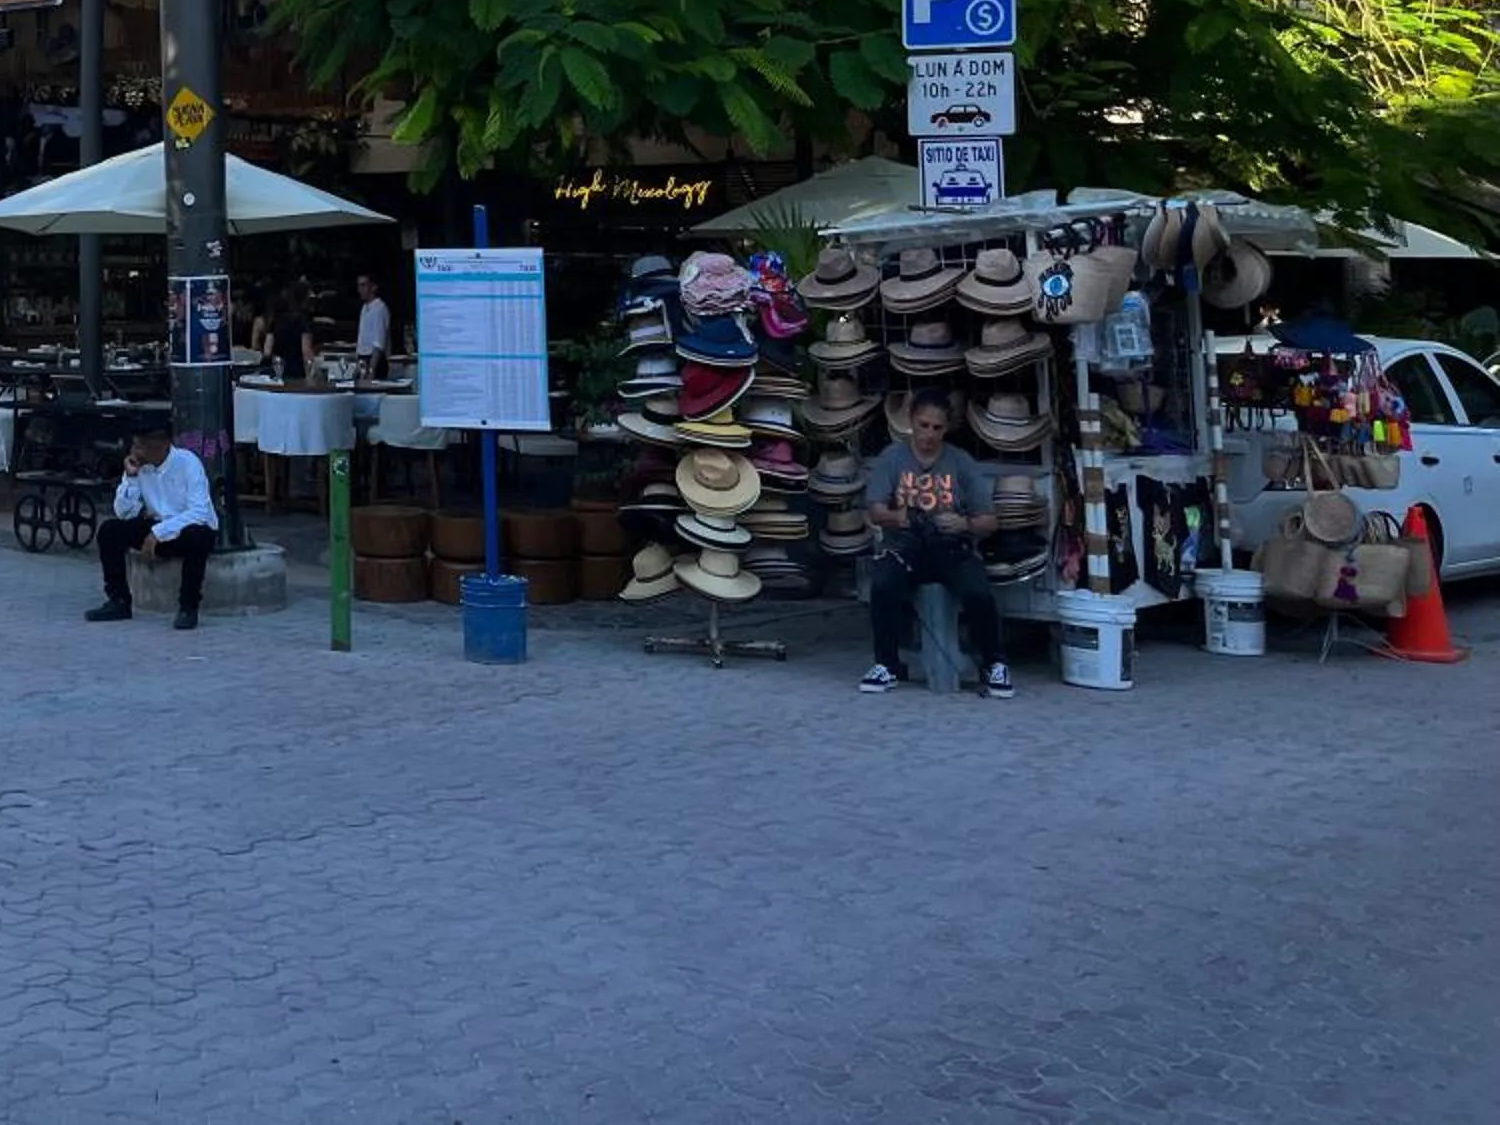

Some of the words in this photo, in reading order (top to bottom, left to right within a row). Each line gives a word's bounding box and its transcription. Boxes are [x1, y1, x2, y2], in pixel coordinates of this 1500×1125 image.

[915, 62, 947, 78] LUN
[969, 59, 1005, 76] DOM
[922, 82, 950, 98] 10h
[965, 81, 997, 98] 22h
[925, 147, 953, 164] SITIO
[955, 146, 969, 163] DE
[972, 145, 995, 162] TAXI
